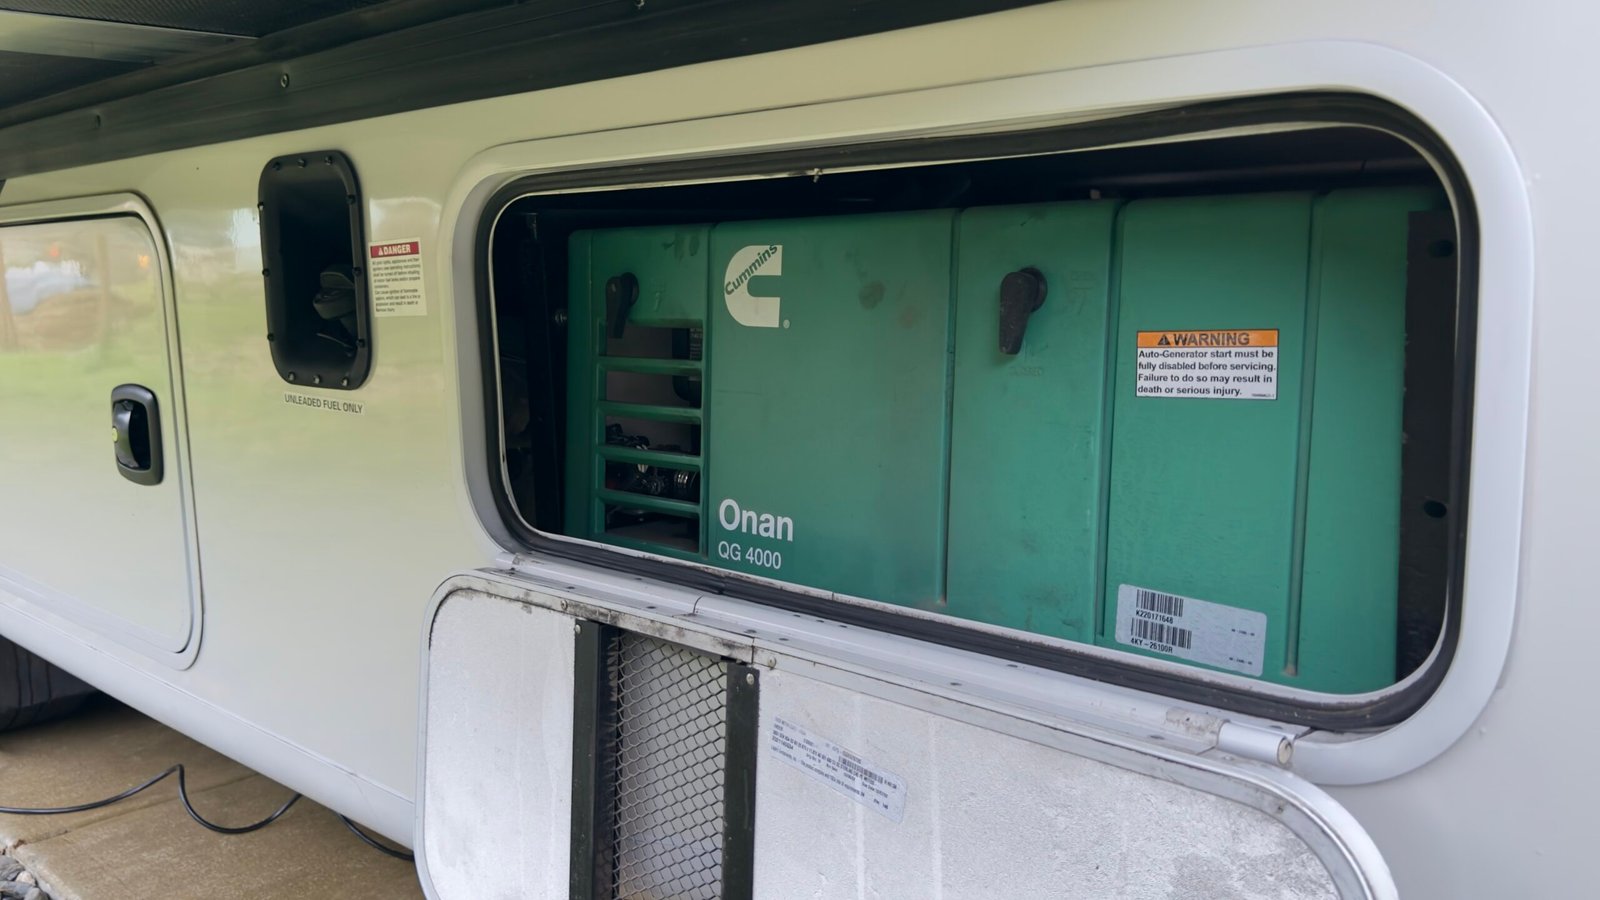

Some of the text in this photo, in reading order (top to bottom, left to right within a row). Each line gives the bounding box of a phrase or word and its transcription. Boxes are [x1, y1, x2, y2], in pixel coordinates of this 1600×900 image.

[383, 244, 411, 255] DANGER
[725, 244, 778, 295] Cummins
[1173, 332, 1250, 346] WARNING
[1138, 349, 1274, 358] Auto-Generator start must be
[1138, 361, 1276, 373] fully disabled before servicing.
[1138, 373, 1169, 382] Failure
[1170, 373, 1180, 382] to
[1181, 373, 1194, 382] do
[1210, 375, 1230, 385] may
[1232, 374, 1261, 383] result
[1263, 374, 1273, 383] in
[1137, 385, 1162, 394] death
[1164, 386, 1174, 394] or
[1176, 386, 1211, 395] serious
[1213, 386, 1242, 397] injury.
[284, 393, 363, 414] UNLEADED FUEL ONLY
[719, 498, 794, 542] Onan
[718, 540, 782, 570] QG 4000
